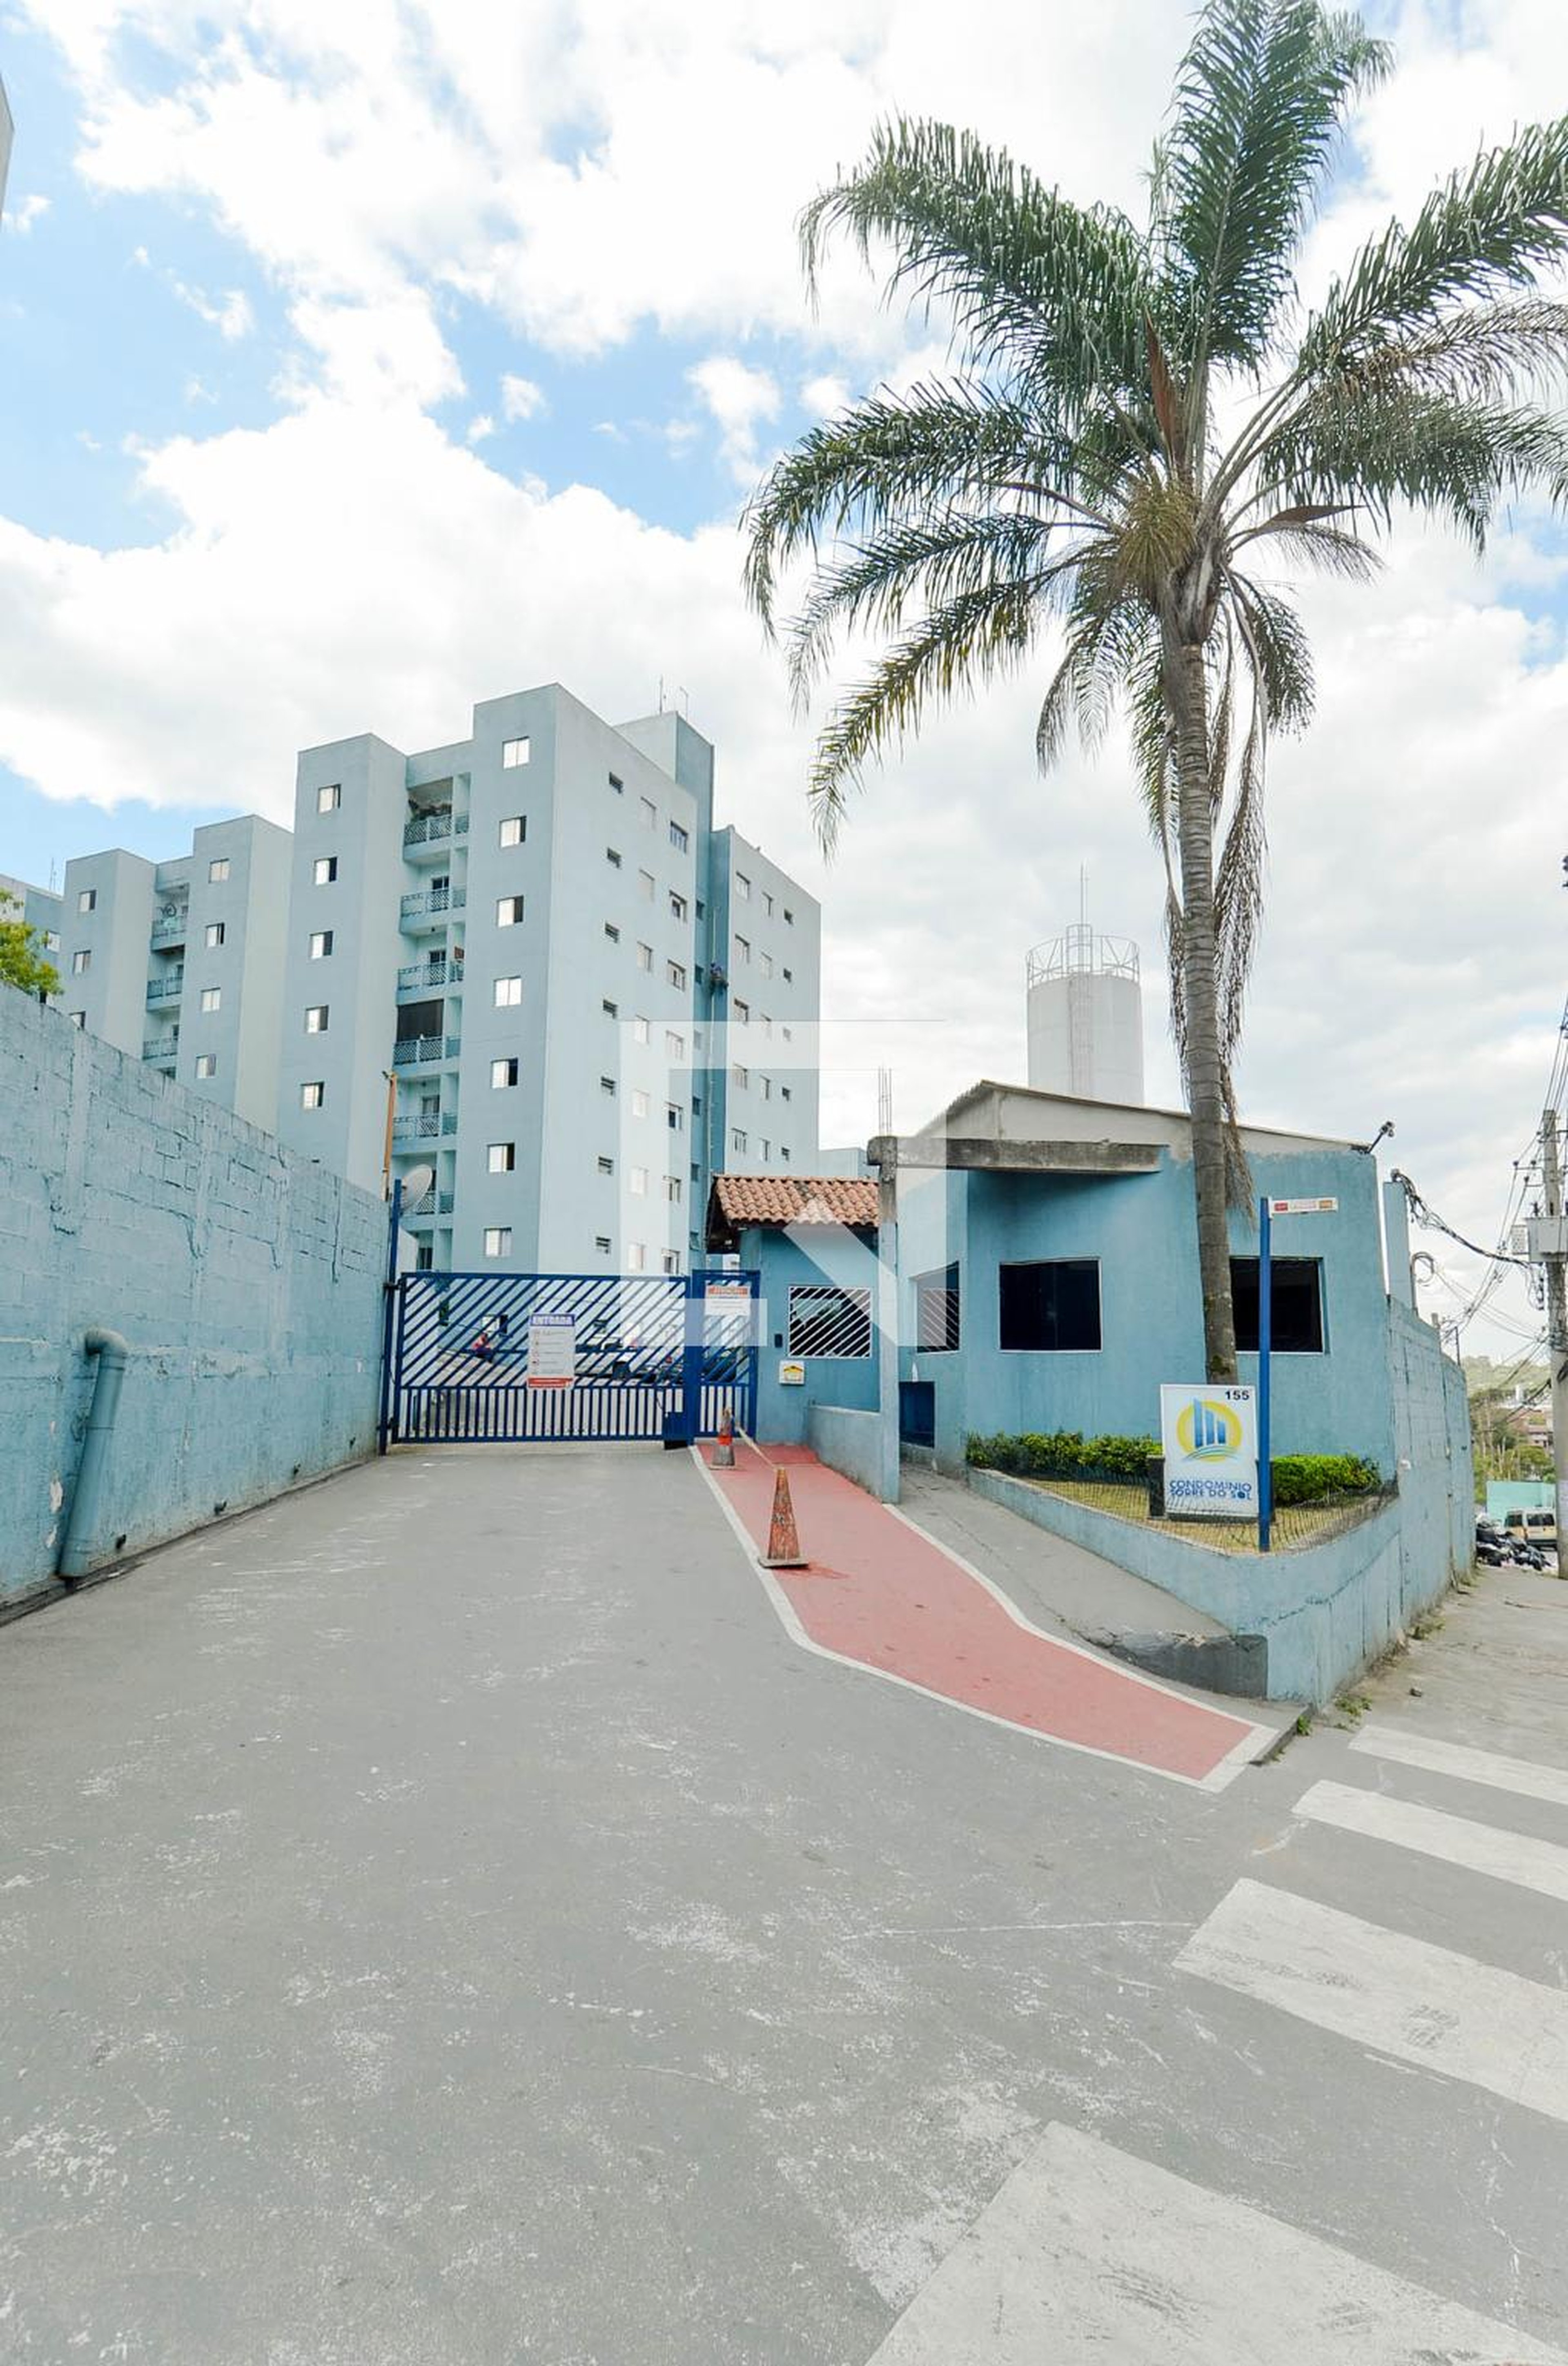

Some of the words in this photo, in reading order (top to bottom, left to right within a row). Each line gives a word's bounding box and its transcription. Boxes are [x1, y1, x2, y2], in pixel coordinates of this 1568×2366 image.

[1225, 1390, 1249, 1400] 155
[1209, 1489, 1226, 1497] DO
[1231, 1490, 1251, 1500] SOL
